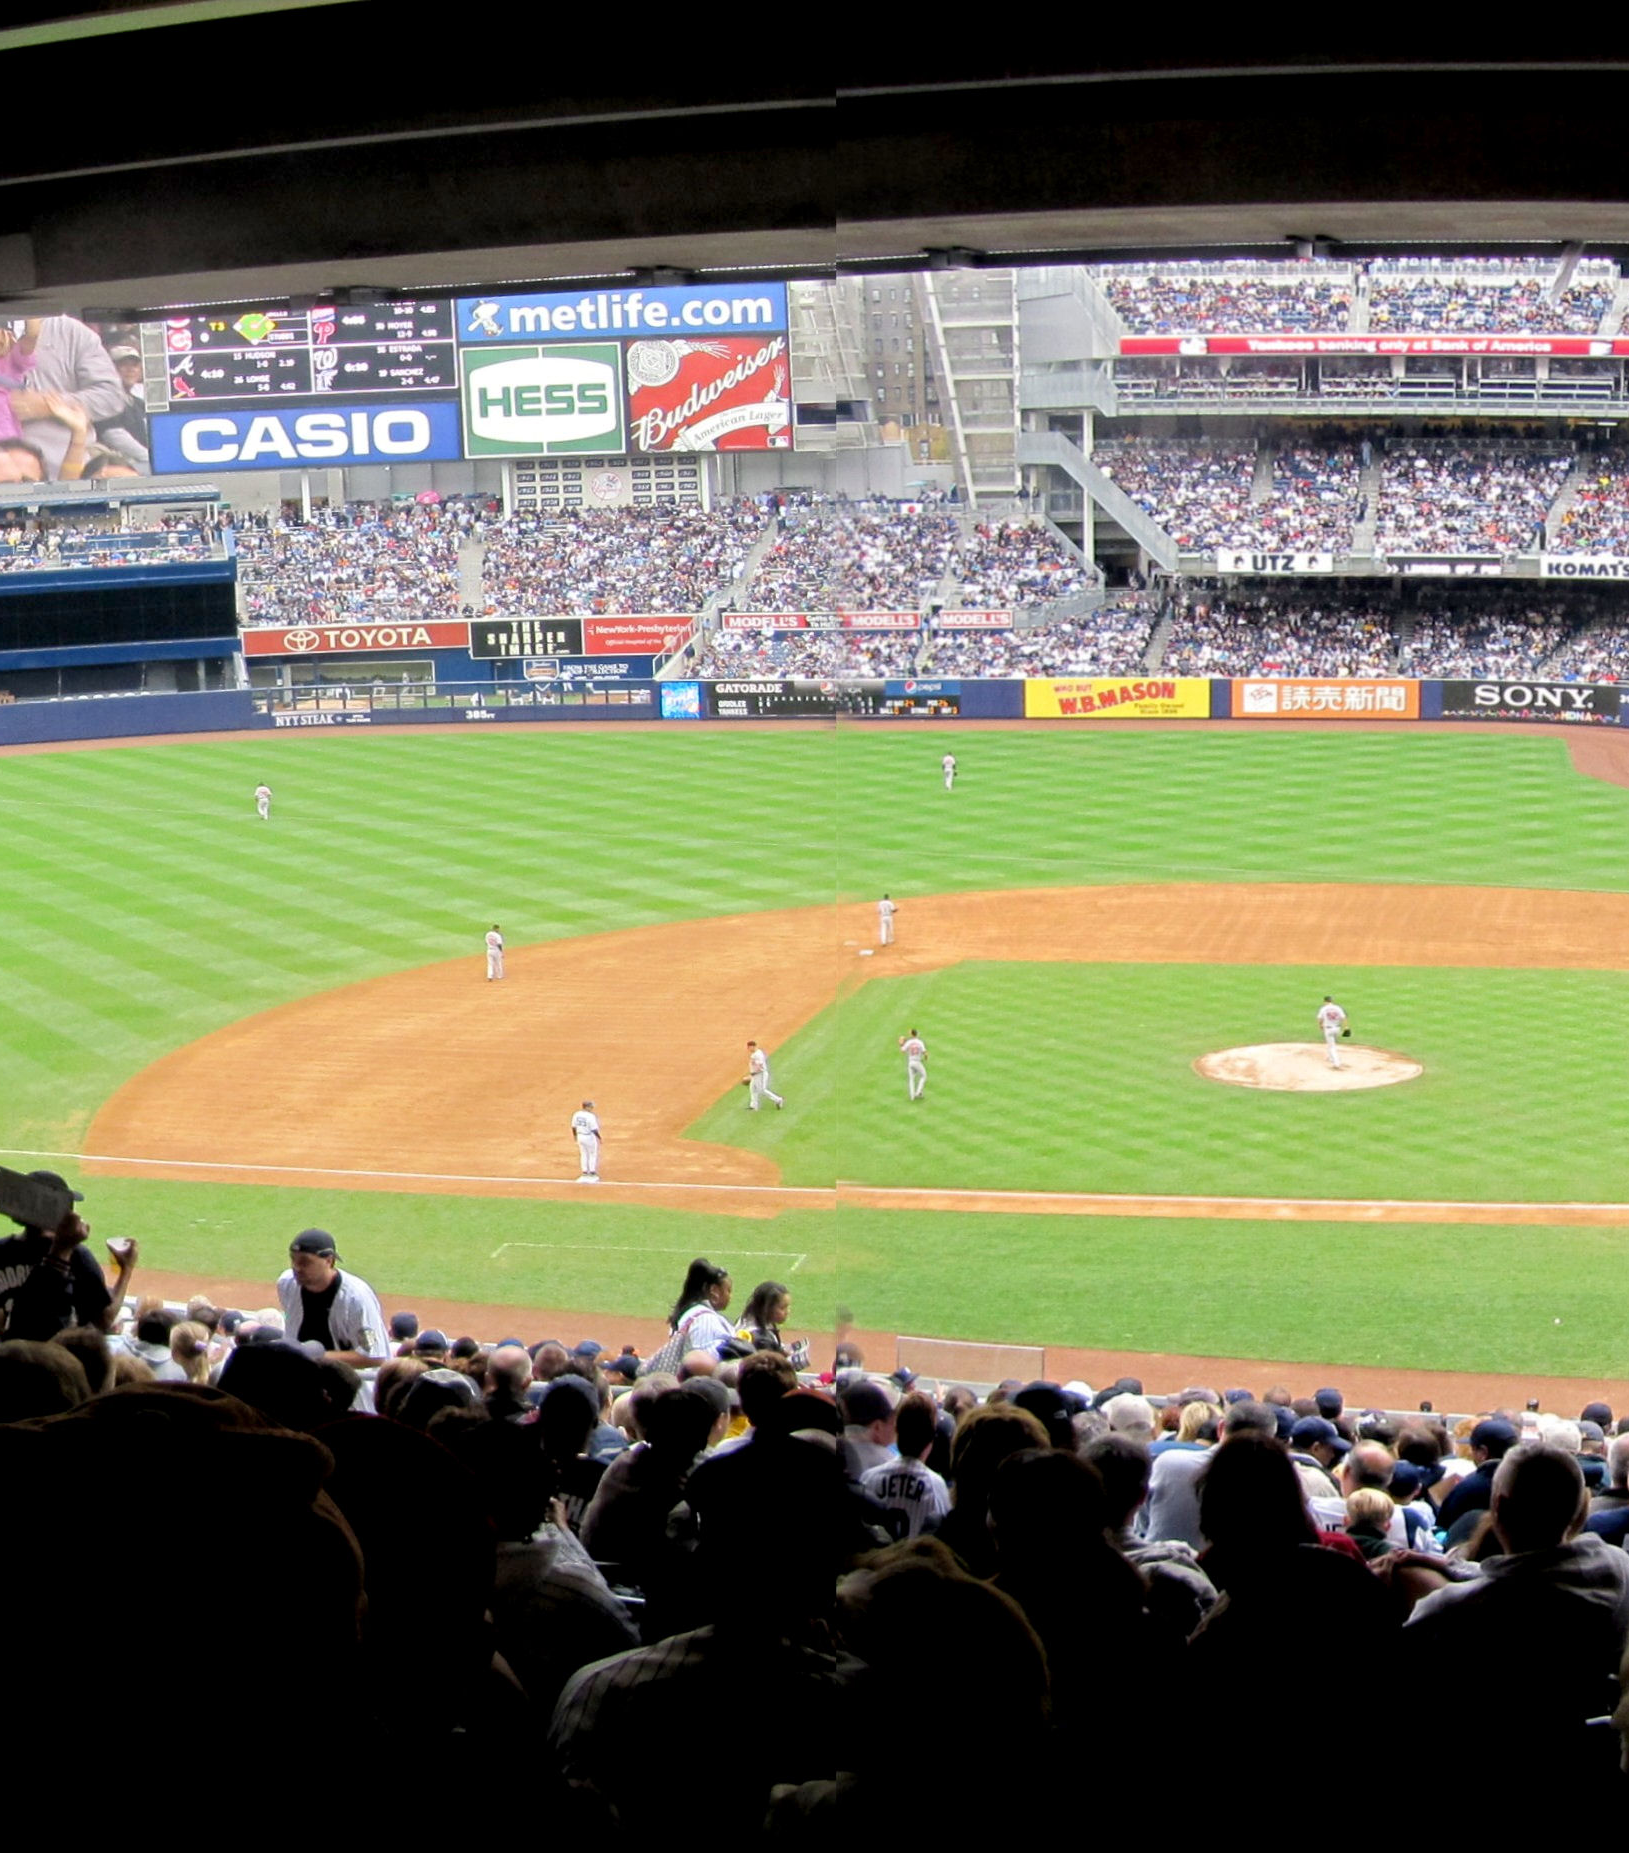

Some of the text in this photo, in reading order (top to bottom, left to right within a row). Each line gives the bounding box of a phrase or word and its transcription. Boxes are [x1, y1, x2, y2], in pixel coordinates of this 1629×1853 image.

[509, 293, 773, 333] metlife.com
[1319, 338, 1375, 353] banking
[1380, 338, 1410, 353] only
[1413, 340, 1429, 352] at
[1432, 338, 1469, 352] Bank
[1473, 339, 1488, 352] of
[1491, 340, 1551, 353] America
[478, 382, 607, 418] HESS
[630, 336, 787, 450] Budweiser
[694, 408, 785, 442] American Lager
[179, 409, 431, 463] CASIO
[1252, 554, 1295, 572] UTZ
[511, 621, 541, 632] THE
[729, 614, 799, 628] MODELL'S
[850, 614, 916, 627] MODELL'S
[941, 613, 1010, 626] MODELL'S
[324, 627, 432, 648] TOYOTA
[486, 632, 566, 646] SHARPER
[715, 683, 783, 694] GATORADE
[1282, 685, 1406, 711] 読売新聞
[276, 715, 300, 727] NYY
[300, 714, 335, 726] STEAK
[875, 1473, 926, 1503] JETER
